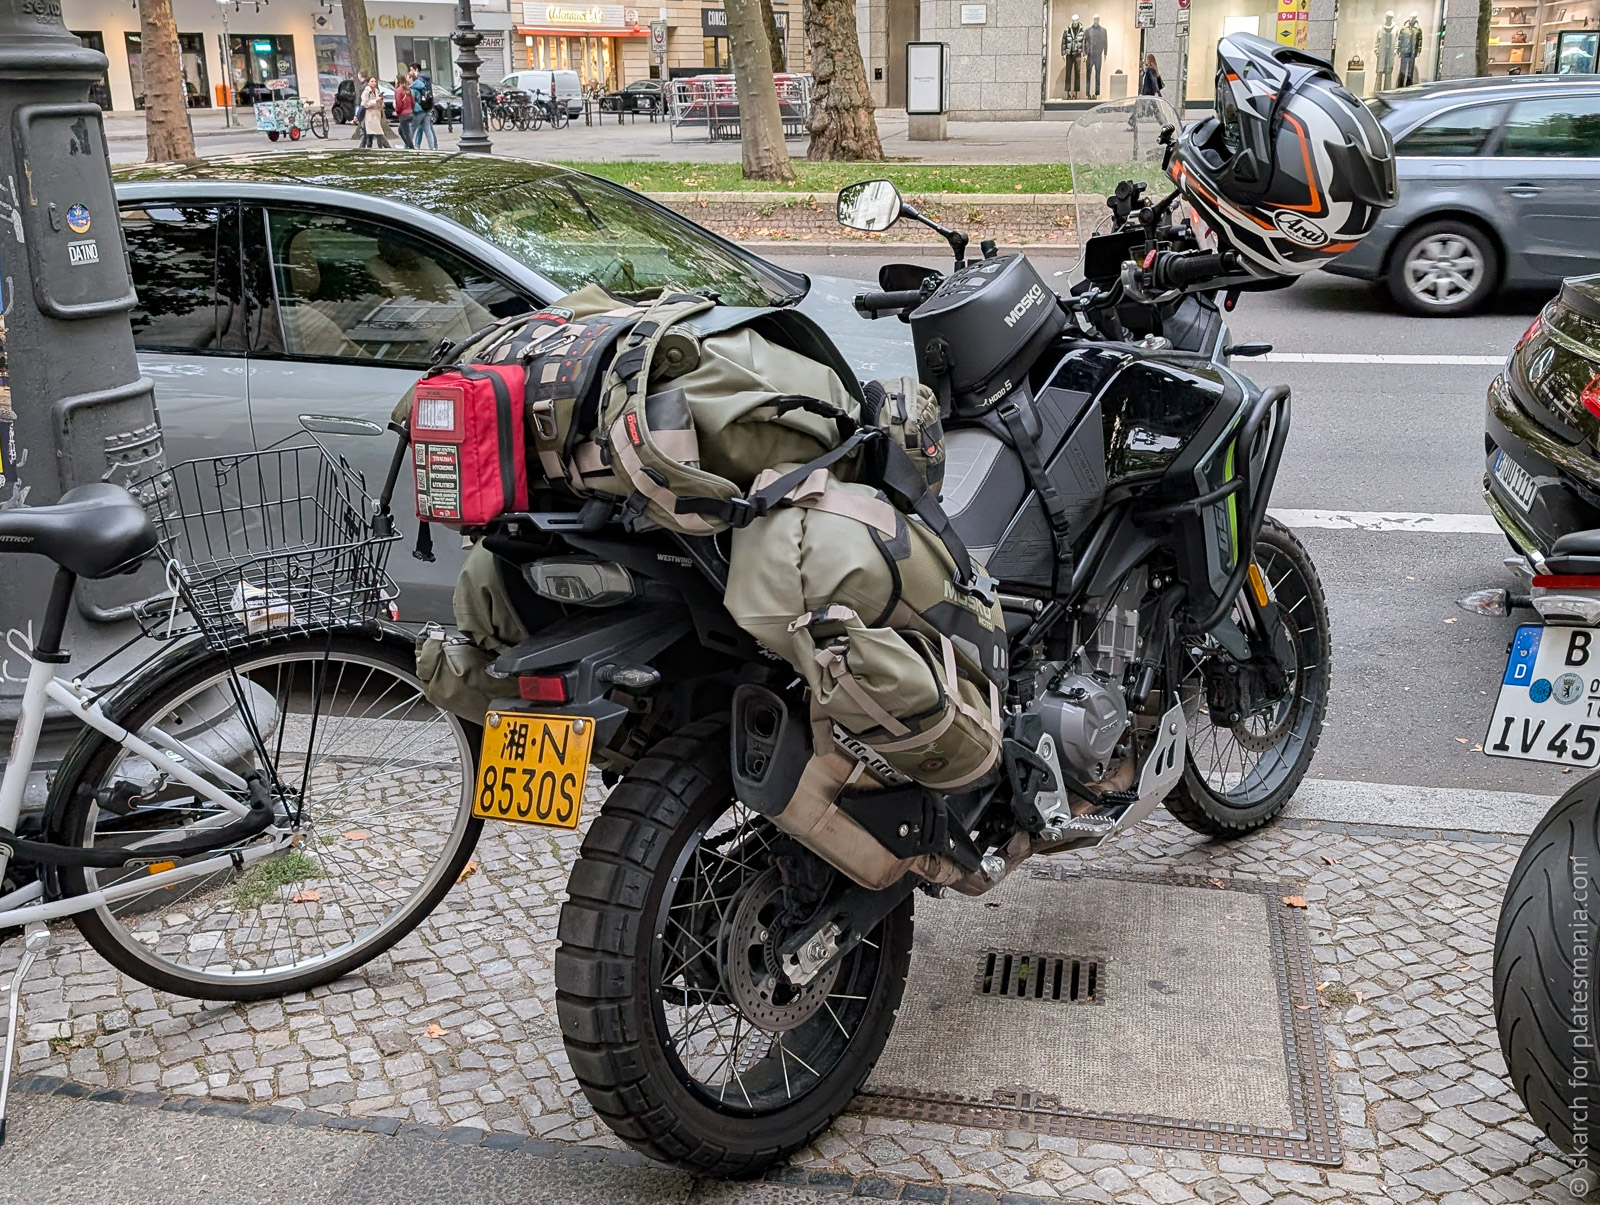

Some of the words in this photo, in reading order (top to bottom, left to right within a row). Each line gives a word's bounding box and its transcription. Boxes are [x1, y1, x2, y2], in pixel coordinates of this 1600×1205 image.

[1276, 218, 1326, 242] Arai
[1003, 283, 1042, 328] MOSKO
[1565, 630, 1592, 666] B
[1514, 663, 1527, 679] D
[501, 721, 570, 766] 湘·N
[1493, 716, 1546, 754] IV
[1547, 723, 1600, 761] 45
[480, 765, 577, 823] 8530S
